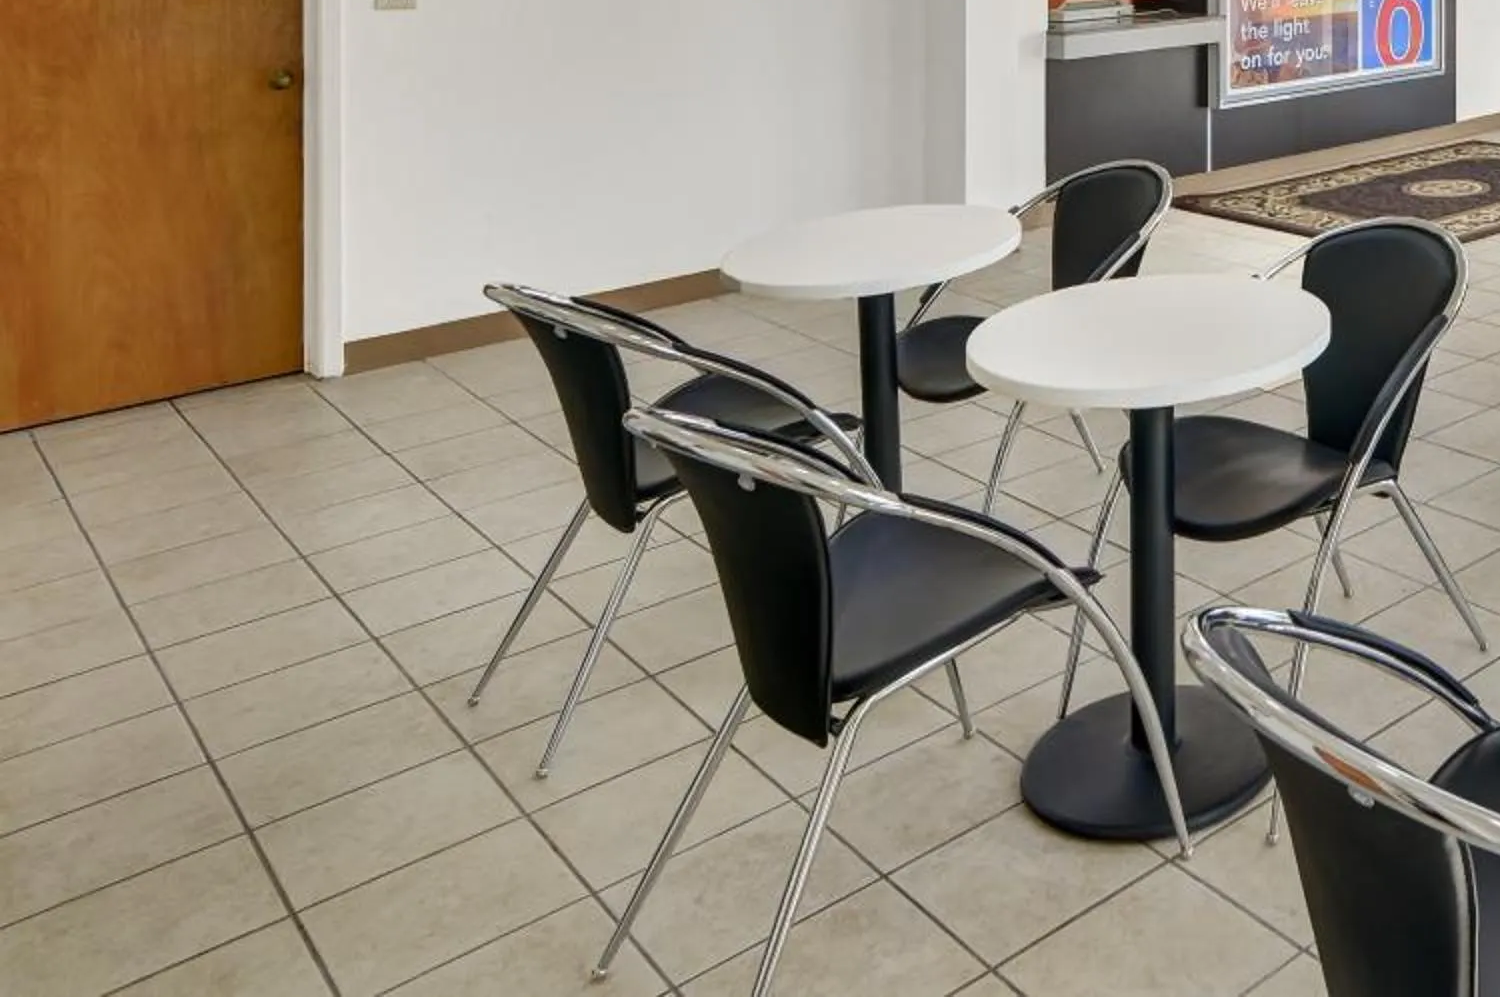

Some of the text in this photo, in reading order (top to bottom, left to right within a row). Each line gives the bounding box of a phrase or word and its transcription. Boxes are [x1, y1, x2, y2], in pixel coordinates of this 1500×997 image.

[1240, 17, 1311, 42] the light
[1240, 55, 1263, 70] on
[1266, 47, 1290, 65] for
